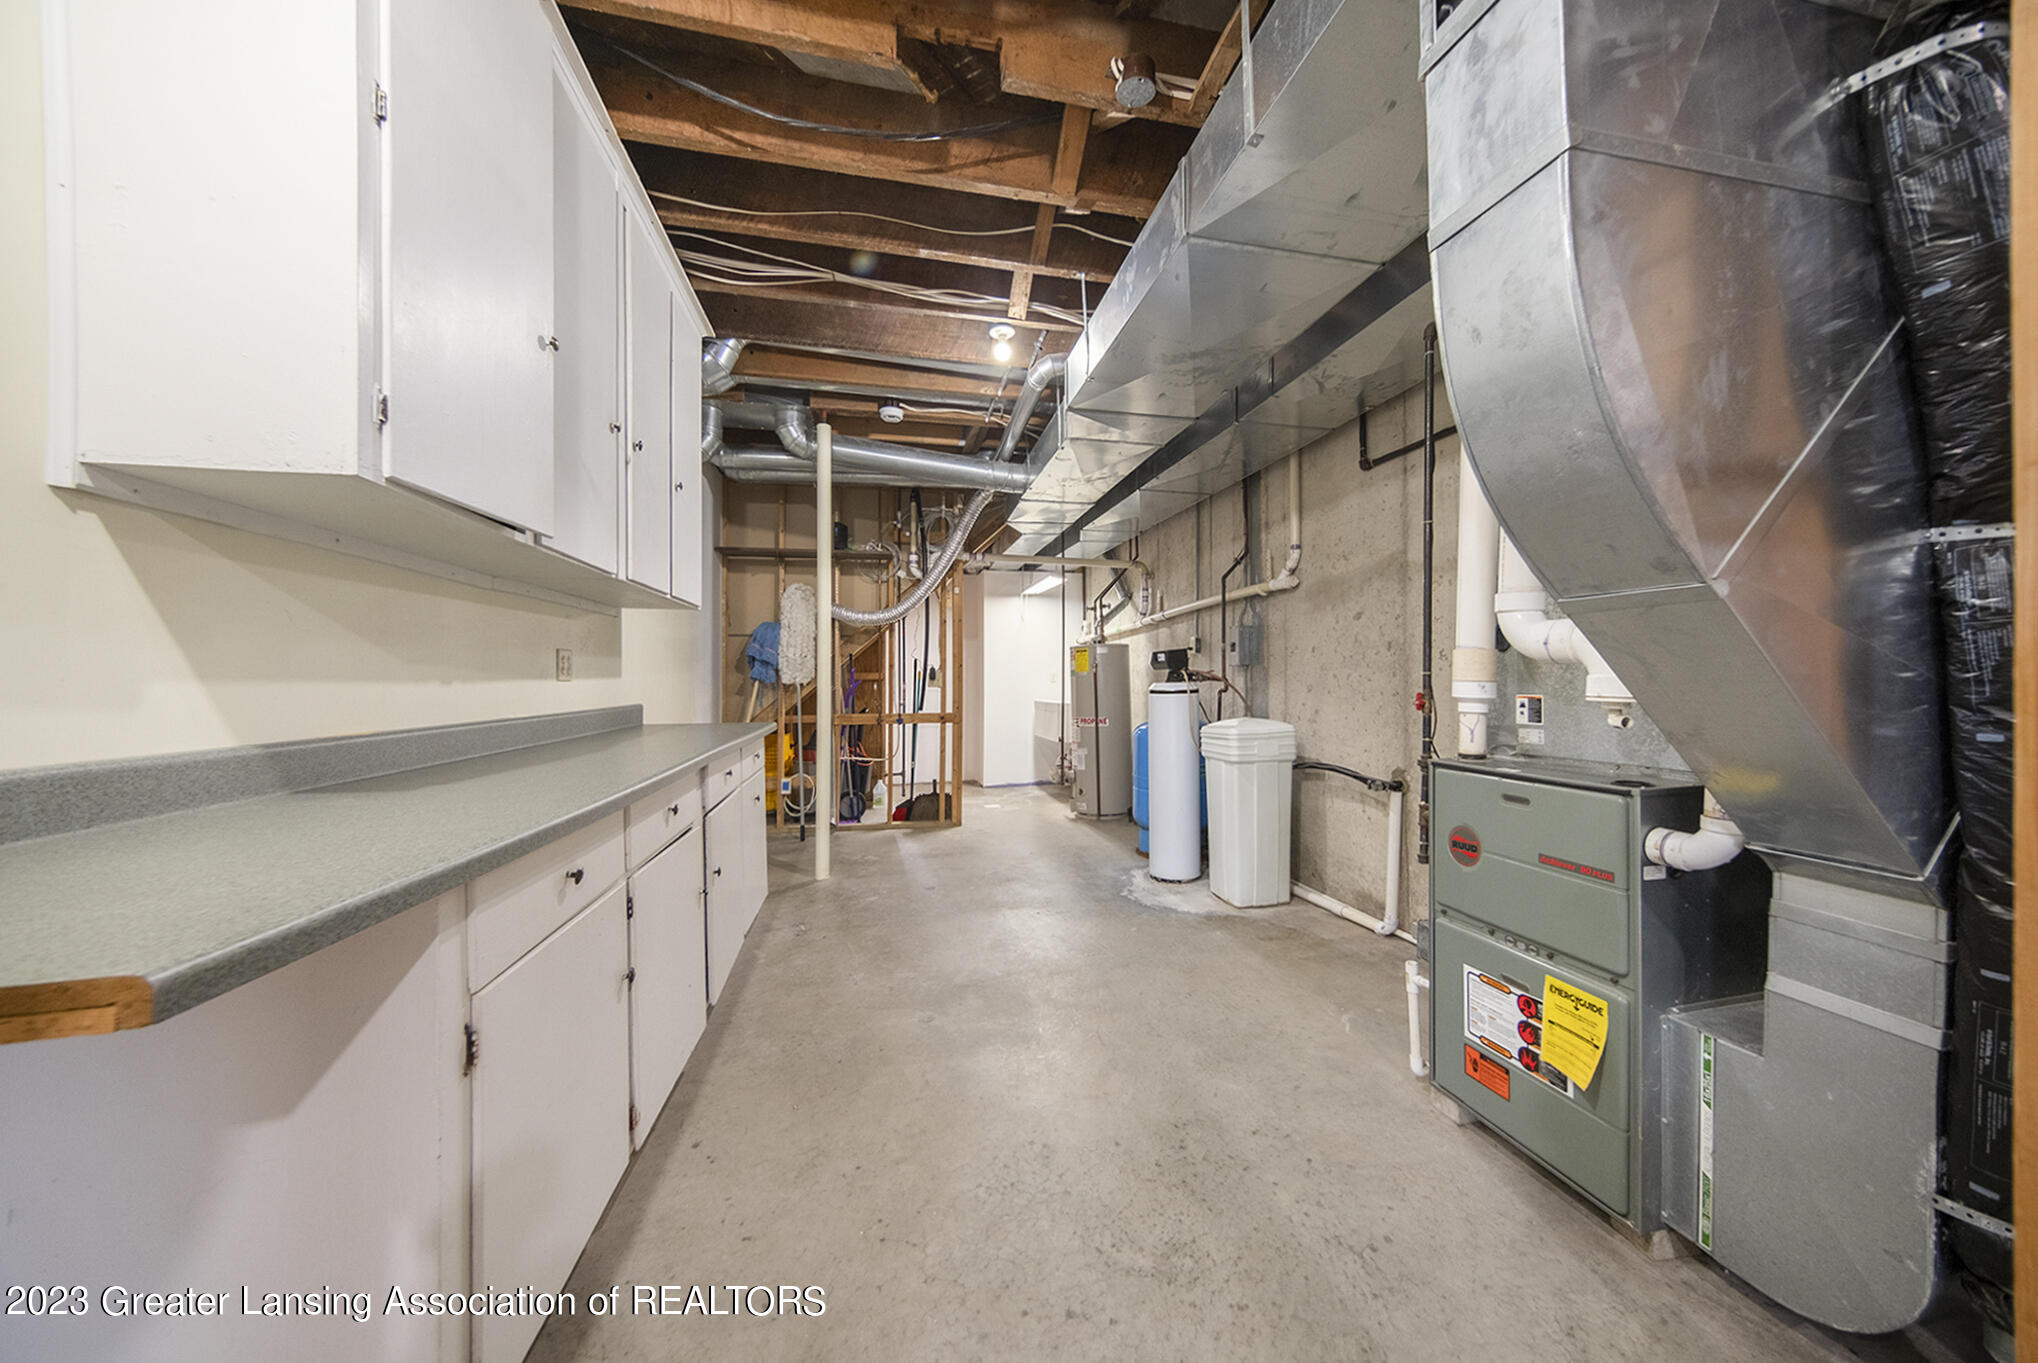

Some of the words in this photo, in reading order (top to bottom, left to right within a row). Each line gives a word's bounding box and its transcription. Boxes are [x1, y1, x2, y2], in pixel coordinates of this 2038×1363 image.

[1080, 717, 1107, 726] PROPNE
[1452, 839, 1478, 853] RUUD
[1541, 855, 1576, 871] Achiever
[1592, 869, 1613, 881] PLUS
